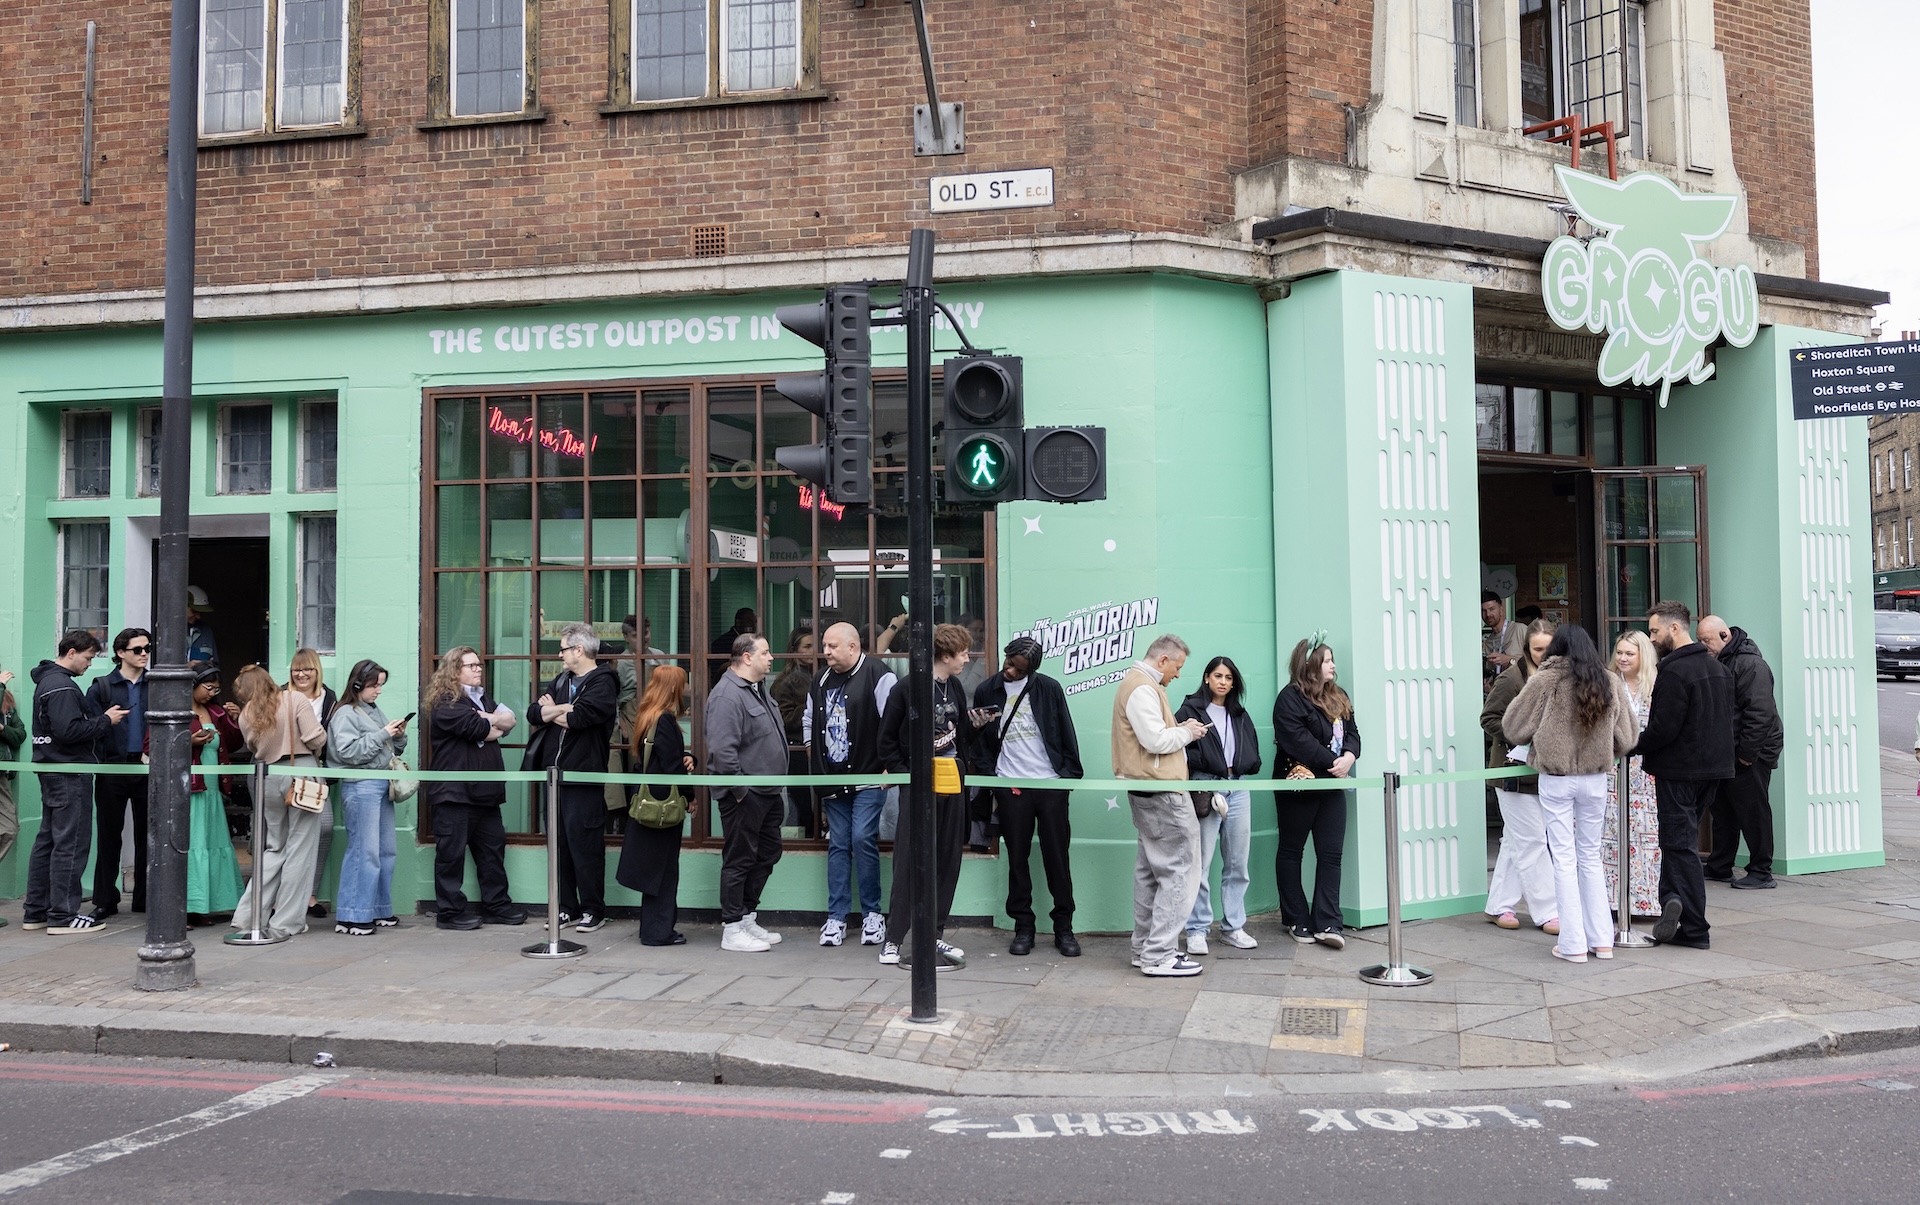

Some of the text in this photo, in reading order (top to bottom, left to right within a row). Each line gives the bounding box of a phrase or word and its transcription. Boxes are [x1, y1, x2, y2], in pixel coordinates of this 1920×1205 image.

[939, 183, 977, 202] OLD
[989, 180, 1018, 199] ST.
[1542, 236, 1759, 349] GROGU
[429, 328, 483, 355] THE
[494, 322, 599, 352] CUTEST
[604, 315, 741, 347] OUTPOST
[750, 313, 780, 341] IN
[1810, 347, 1872, 361] Shoreditch
[1874, 345, 1906, 356] Town
[1811, 364, 1896, 378] Hoxton Square
[1812, 384, 1872, 396] Old Street
[1814, 401, 1875, 414] Moorfields
[1876, 400, 1897, 412] Eye
[730, 535, 746, 547] BREAD
[730, 548, 746, 559] AHEAD
[769, 551, 798, 560] ATCHA
[1065, 600, 1113, 618] STAR WARS
[1034, 617, 1052, 631] THE
[1044, 645, 1066, 658] AND
[1063, 630, 1135, 675] GROGU
[1065, 675, 1107, 696] CINEMAS
[987, 1105, 1543, 1138] LOOK RIGHT
